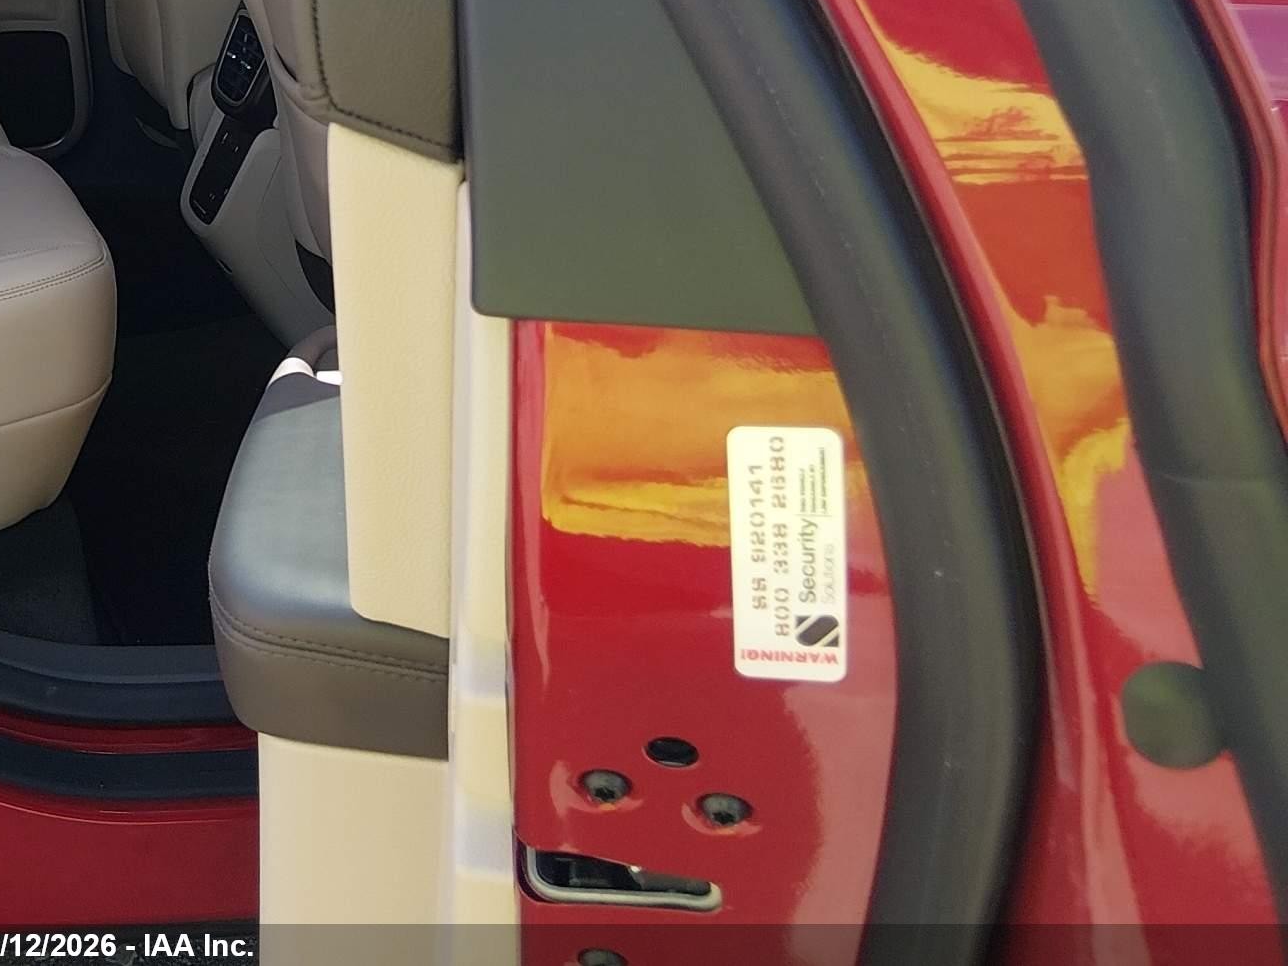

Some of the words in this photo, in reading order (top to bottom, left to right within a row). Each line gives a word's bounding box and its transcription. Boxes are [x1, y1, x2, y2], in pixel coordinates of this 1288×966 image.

[747, 464, 766, 563] 920141
[772, 523, 790, 575] 338
[797, 518, 819, 604] Security
[821, 543, 836, 605] Solutions
[773, 587, 790, 637] 800
[740, 649, 839, 665] WARNING!
